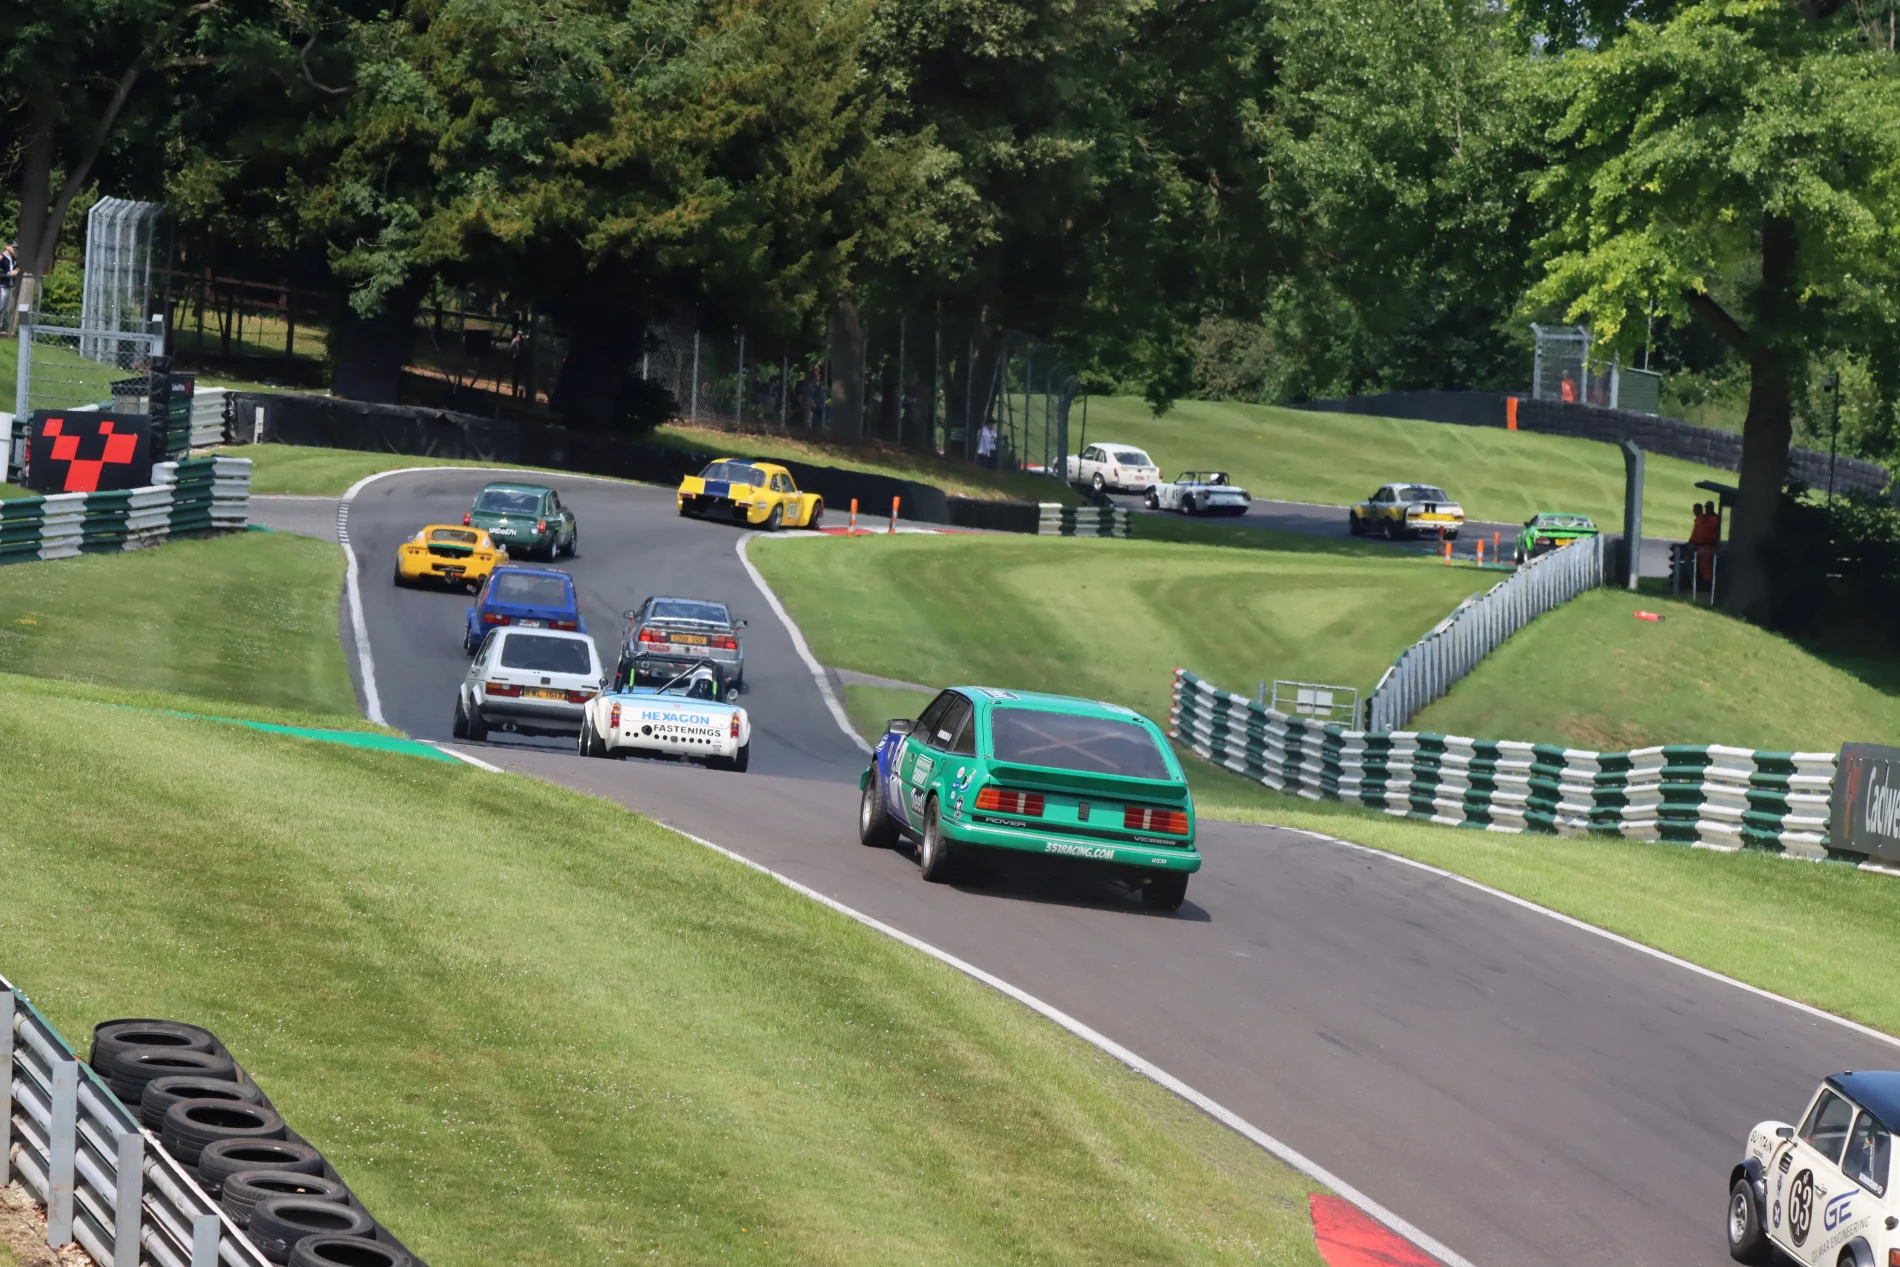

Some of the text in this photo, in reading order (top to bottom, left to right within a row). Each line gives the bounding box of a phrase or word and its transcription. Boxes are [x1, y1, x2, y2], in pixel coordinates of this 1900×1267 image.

[641, 711, 710, 725] HEXAGON
[653, 724, 721, 737] FASTENINGS
[985, 817, 1027, 828] ROVER
[1044, 842, 1115, 859] 351RACING.COM
[1790, 1180, 1812, 1230] 63
